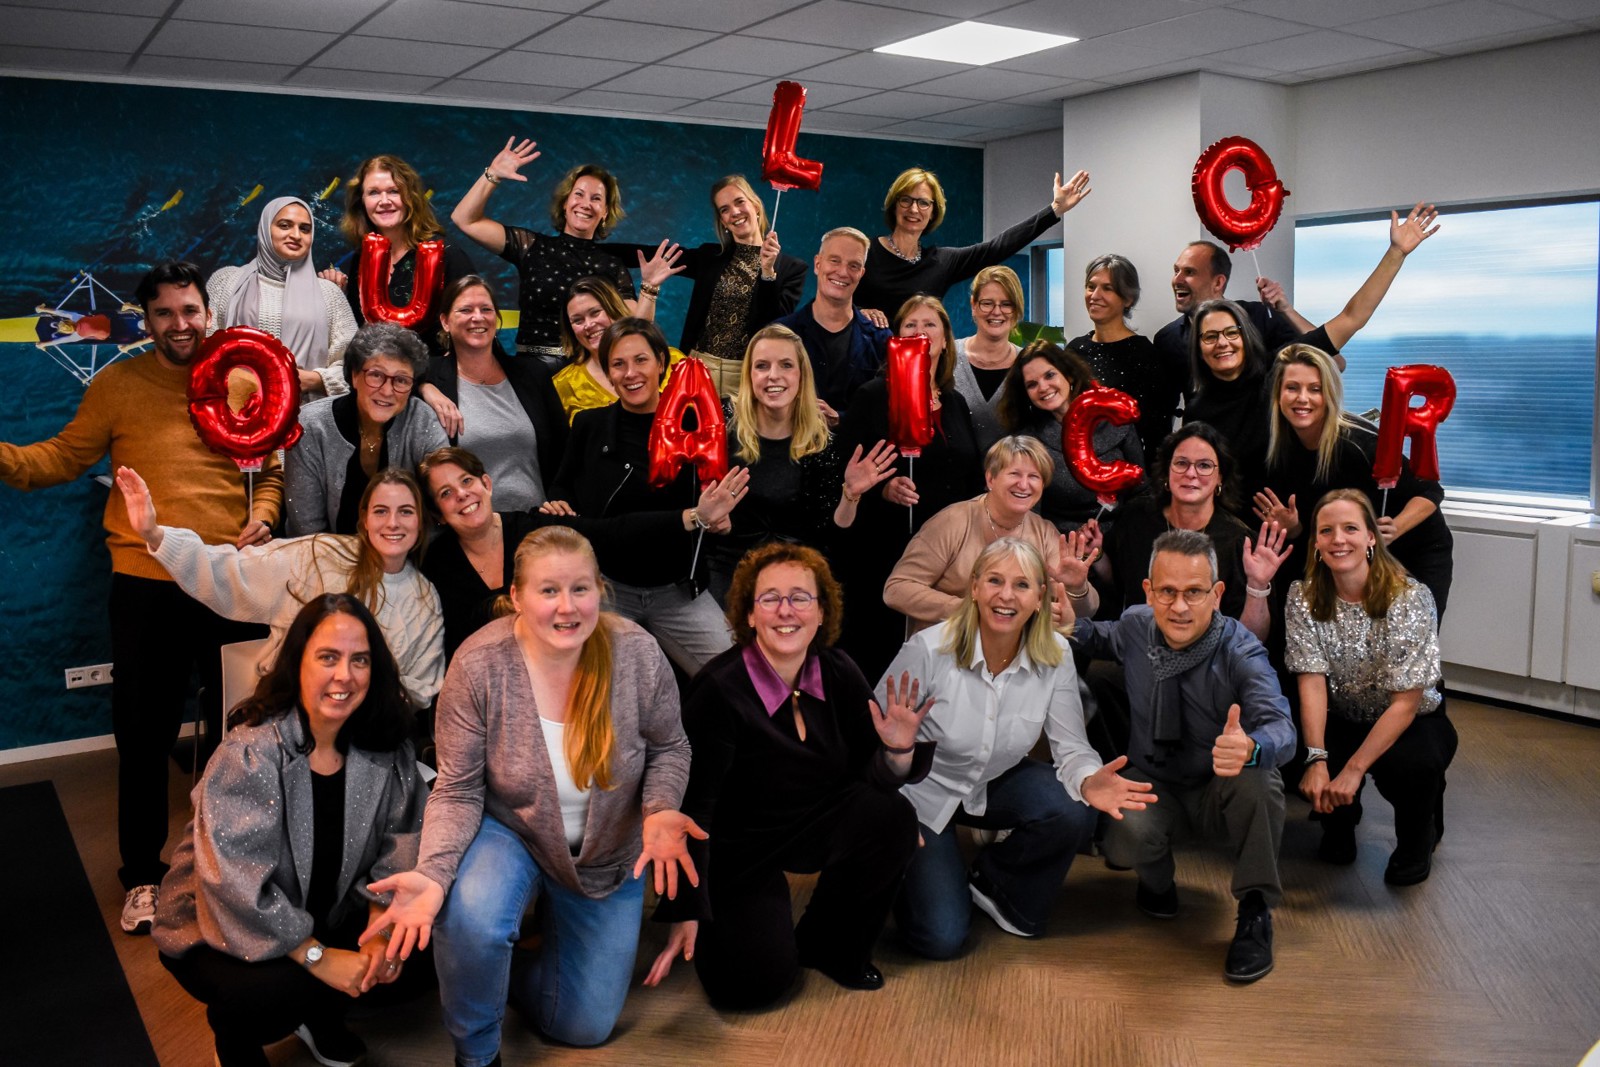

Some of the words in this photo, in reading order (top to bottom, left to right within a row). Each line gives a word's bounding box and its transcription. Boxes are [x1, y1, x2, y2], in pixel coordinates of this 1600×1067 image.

[762, 80, 824, 187] L
[358, 232, 445, 327] U
[648, 357, 729, 491] A
[1062, 383, 1144, 496] C
[1372, 364, 1457, 481] R
